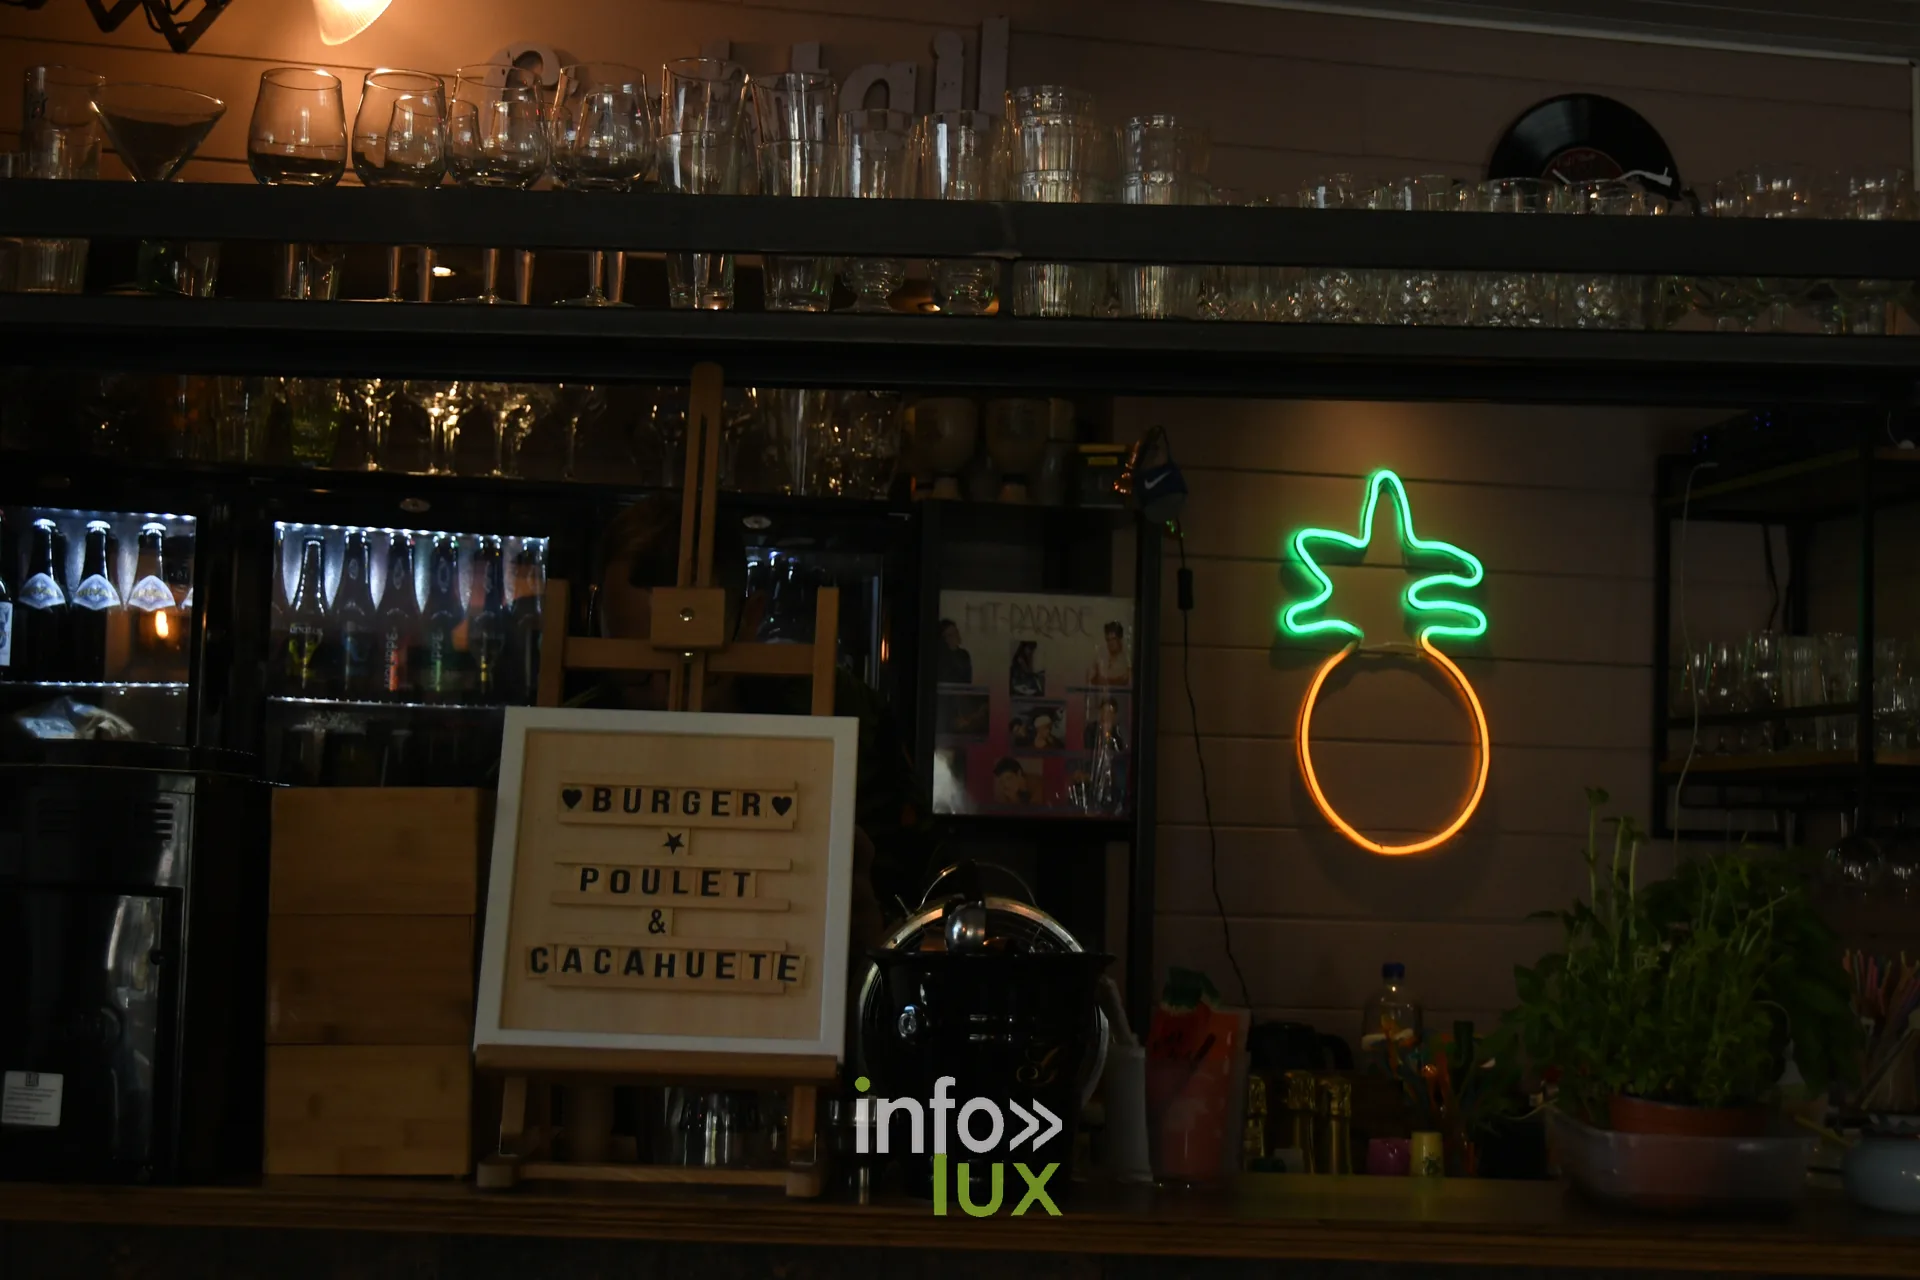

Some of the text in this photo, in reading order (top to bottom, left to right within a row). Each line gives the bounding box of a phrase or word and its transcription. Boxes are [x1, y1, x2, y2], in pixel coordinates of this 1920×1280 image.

[592, 787, 761, 817] BURGER
[580, 867, 750, 898] POULET
[648, 909, 666, 934] &
[530, 946, 800, 982] CACAHUETE
